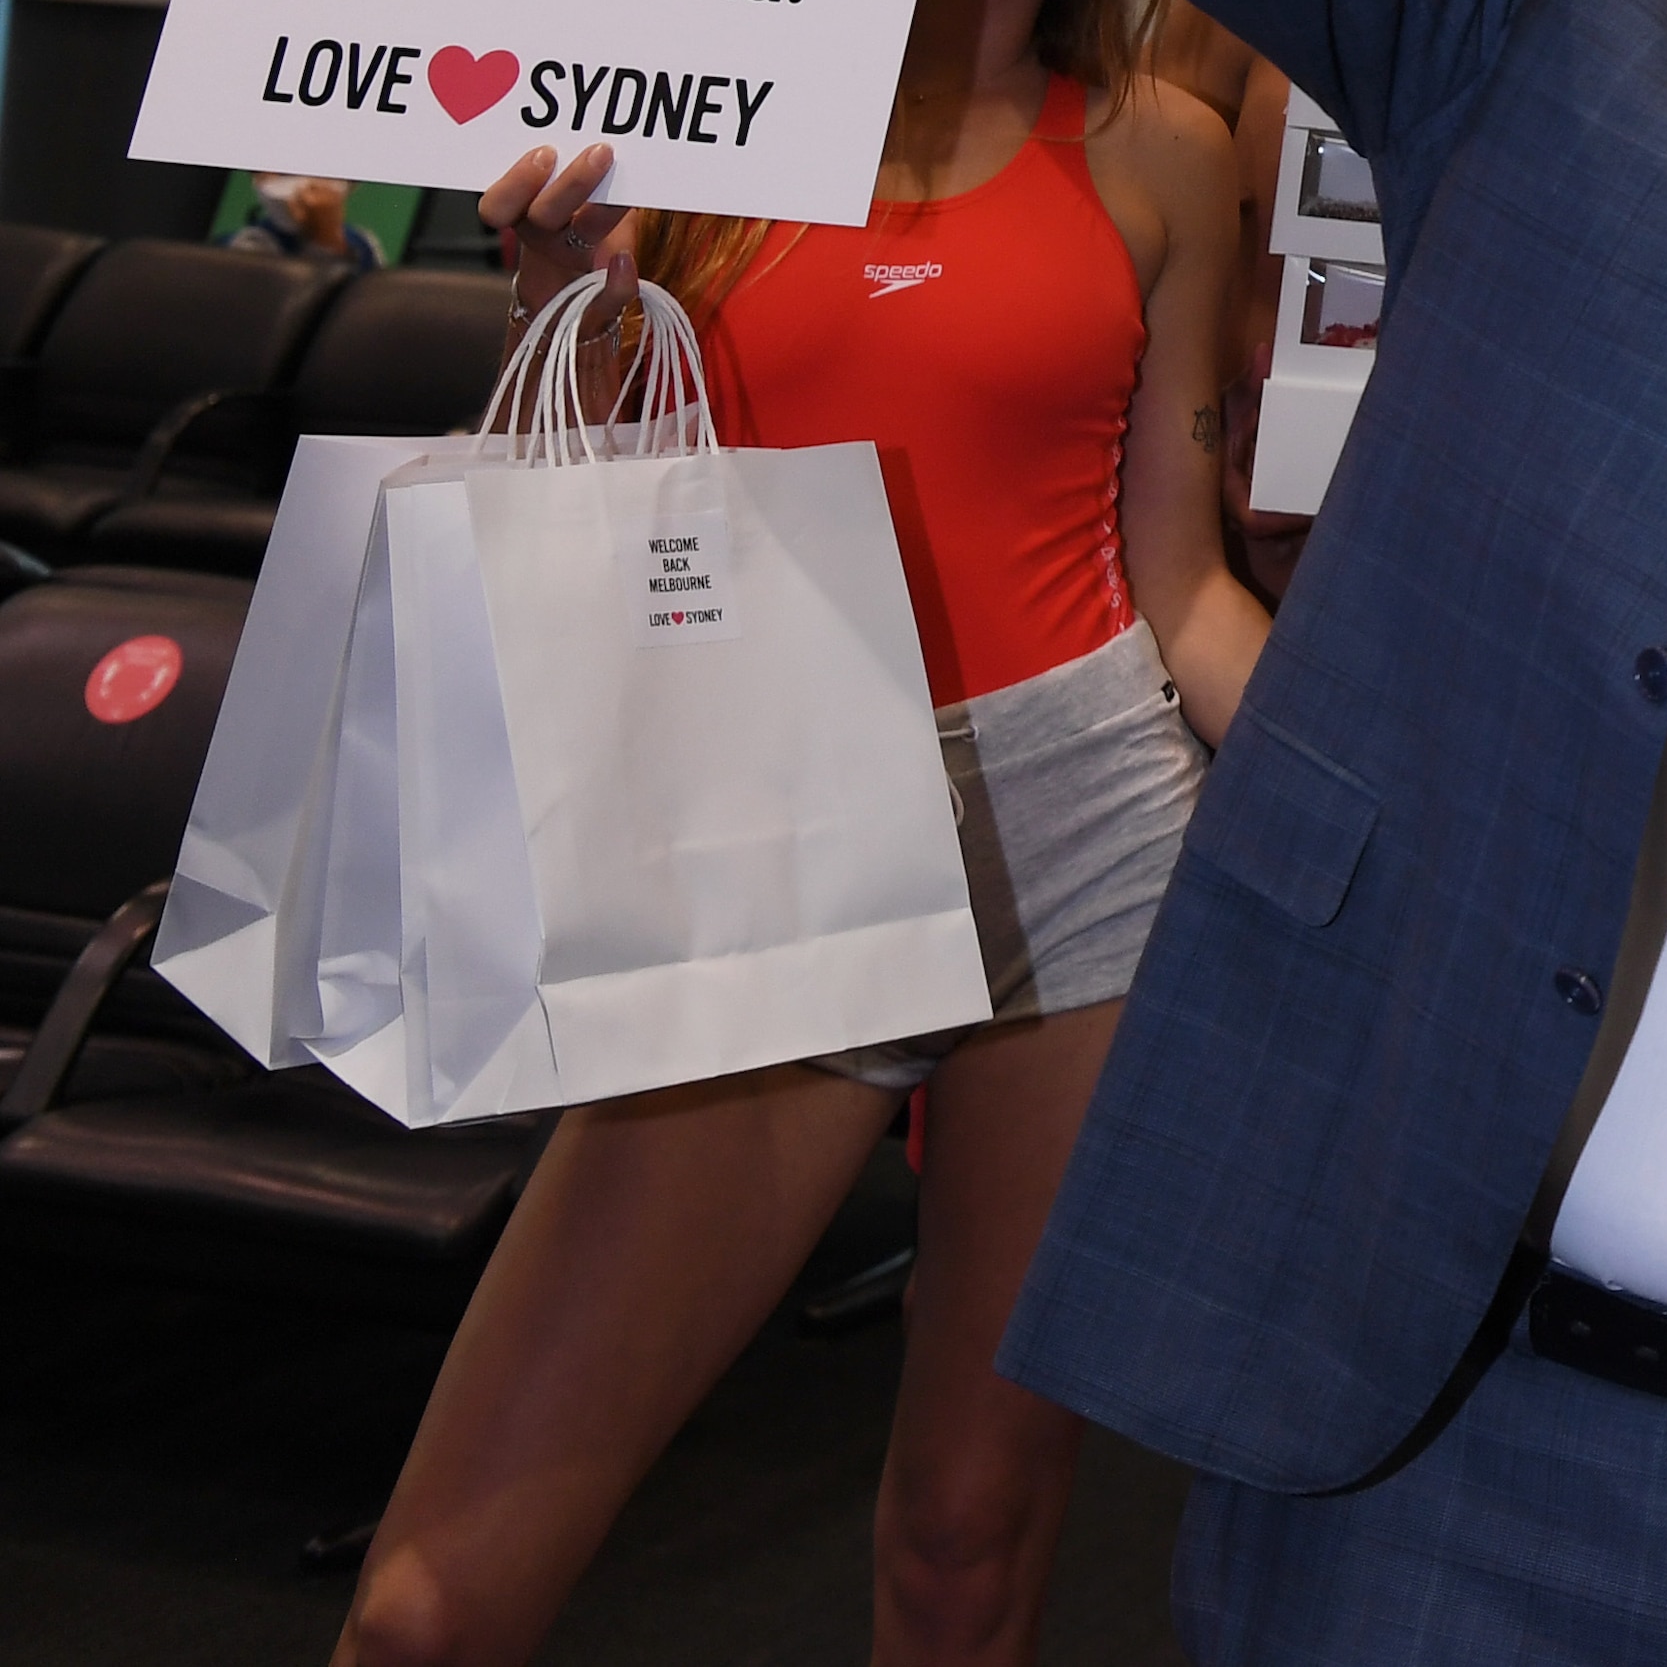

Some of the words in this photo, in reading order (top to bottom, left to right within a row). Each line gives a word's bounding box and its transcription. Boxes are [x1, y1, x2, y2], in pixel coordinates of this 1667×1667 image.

[262, 36, 422, 115] LOVE
[520, 60, 775, 147] SYDNEY
[864, 261, 942, 282] speedo
[648, 536, 700, 554] WELCOME
[662, 557, 691, 573] BACK
[648, 574, 712, 593] MELBOURNE
[649, 613, 671, 626] LOVE
[686, 609, 723, 624] SYDNEY
